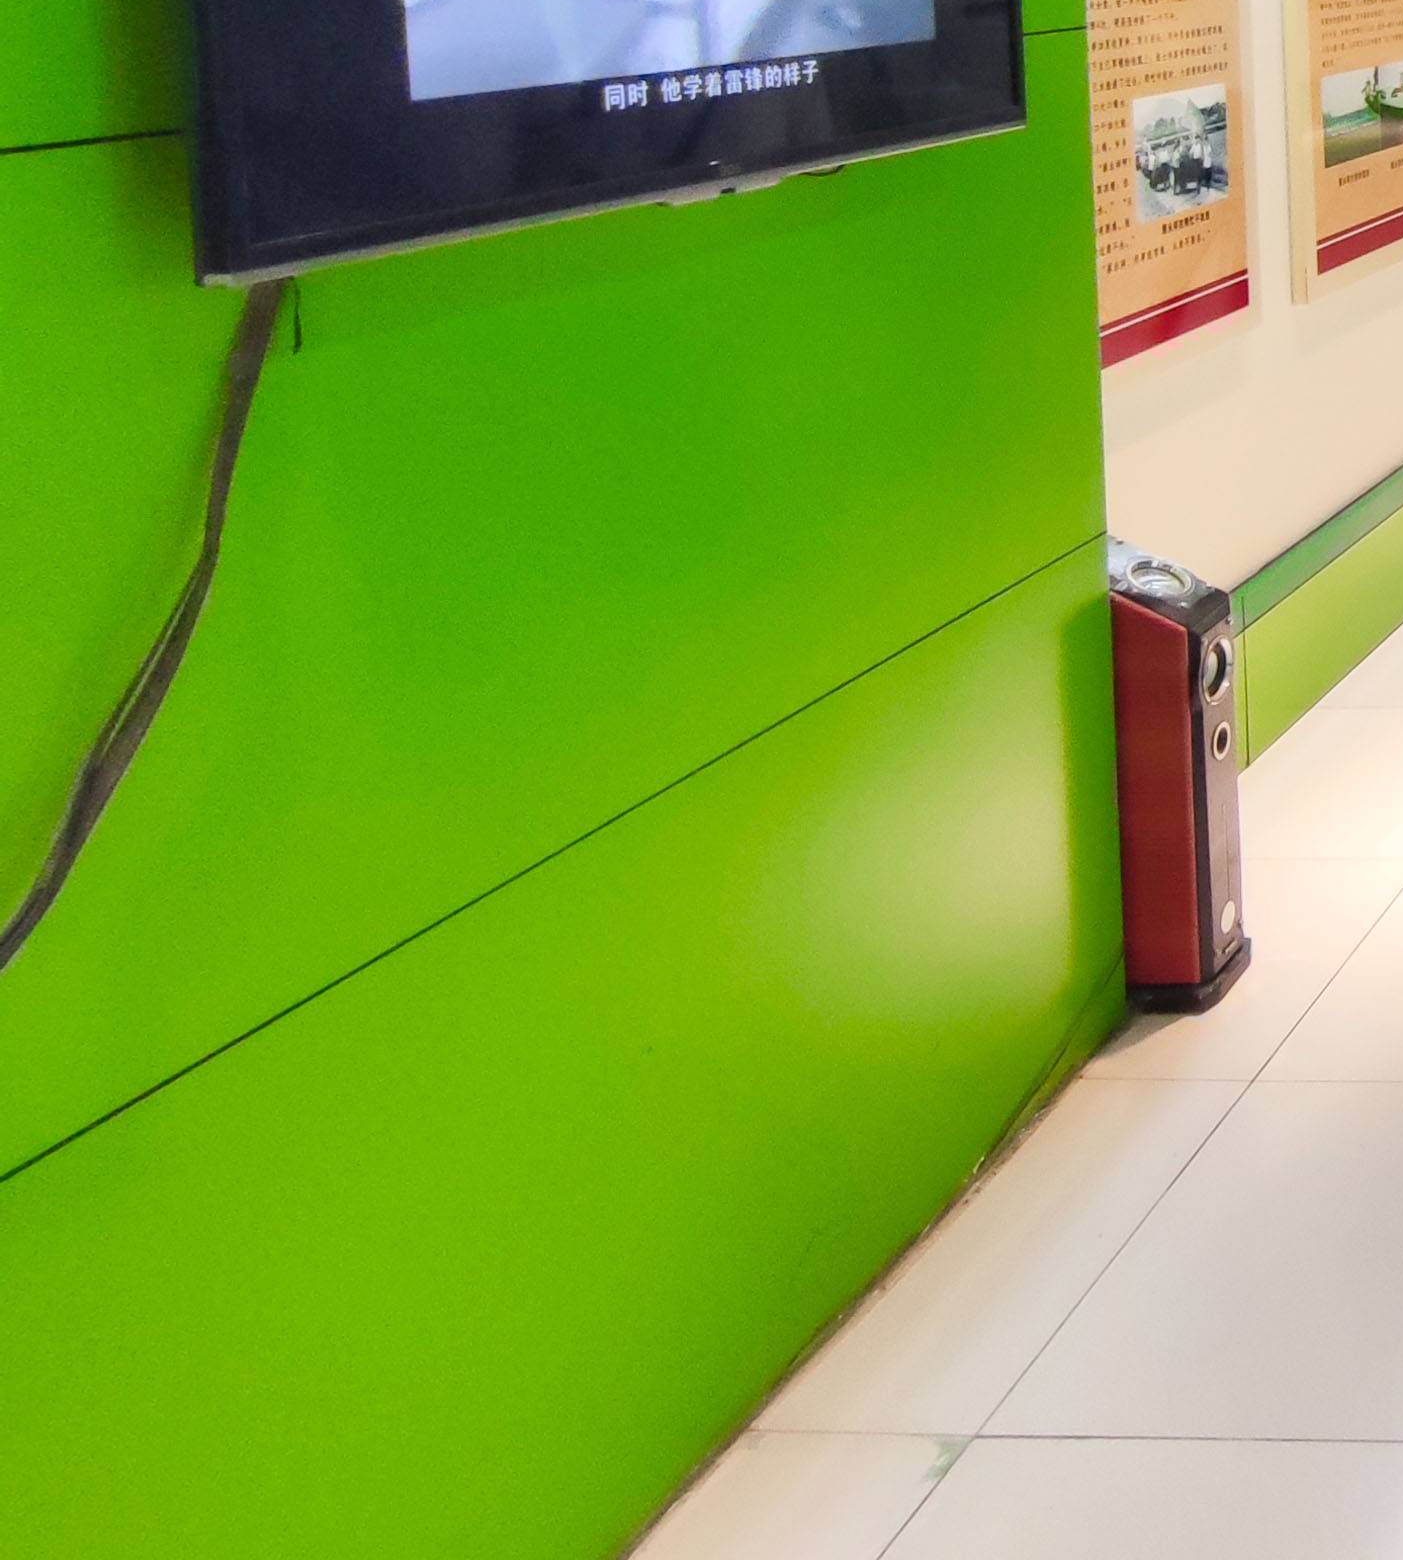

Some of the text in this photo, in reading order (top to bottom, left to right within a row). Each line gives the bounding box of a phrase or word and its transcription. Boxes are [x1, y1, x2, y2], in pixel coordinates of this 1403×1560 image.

[604, 60, 819, 112] 同时 他学着雷锋的样子
